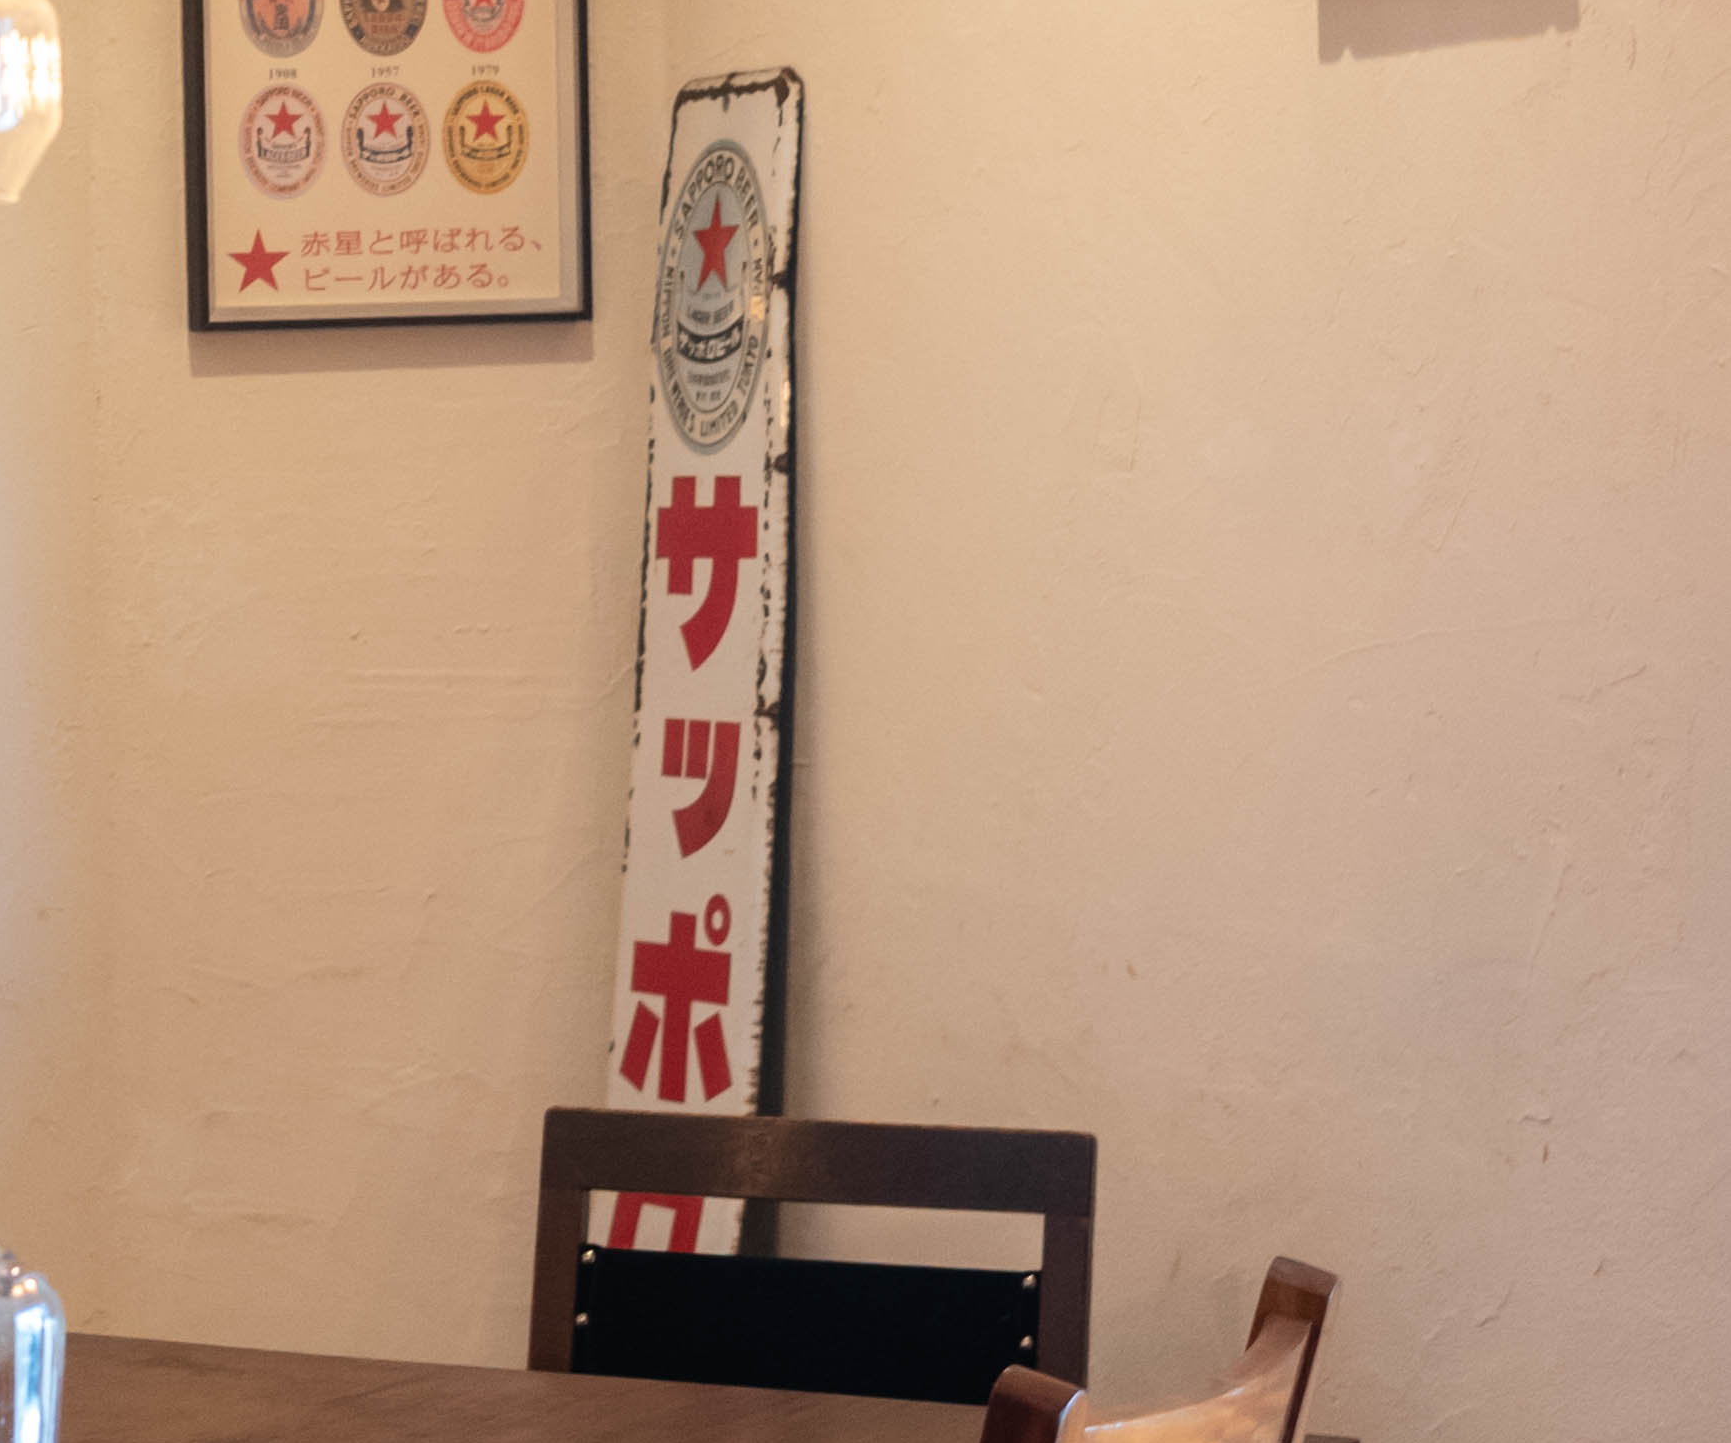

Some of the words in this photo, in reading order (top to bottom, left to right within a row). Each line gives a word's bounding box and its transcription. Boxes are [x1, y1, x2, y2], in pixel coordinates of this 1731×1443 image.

[674, 154, 735, 240] SAPPORO
[300, 226, 542, 256] 赤星と呼ばれる、
[303, 263, 509, 291] ビールがある。
